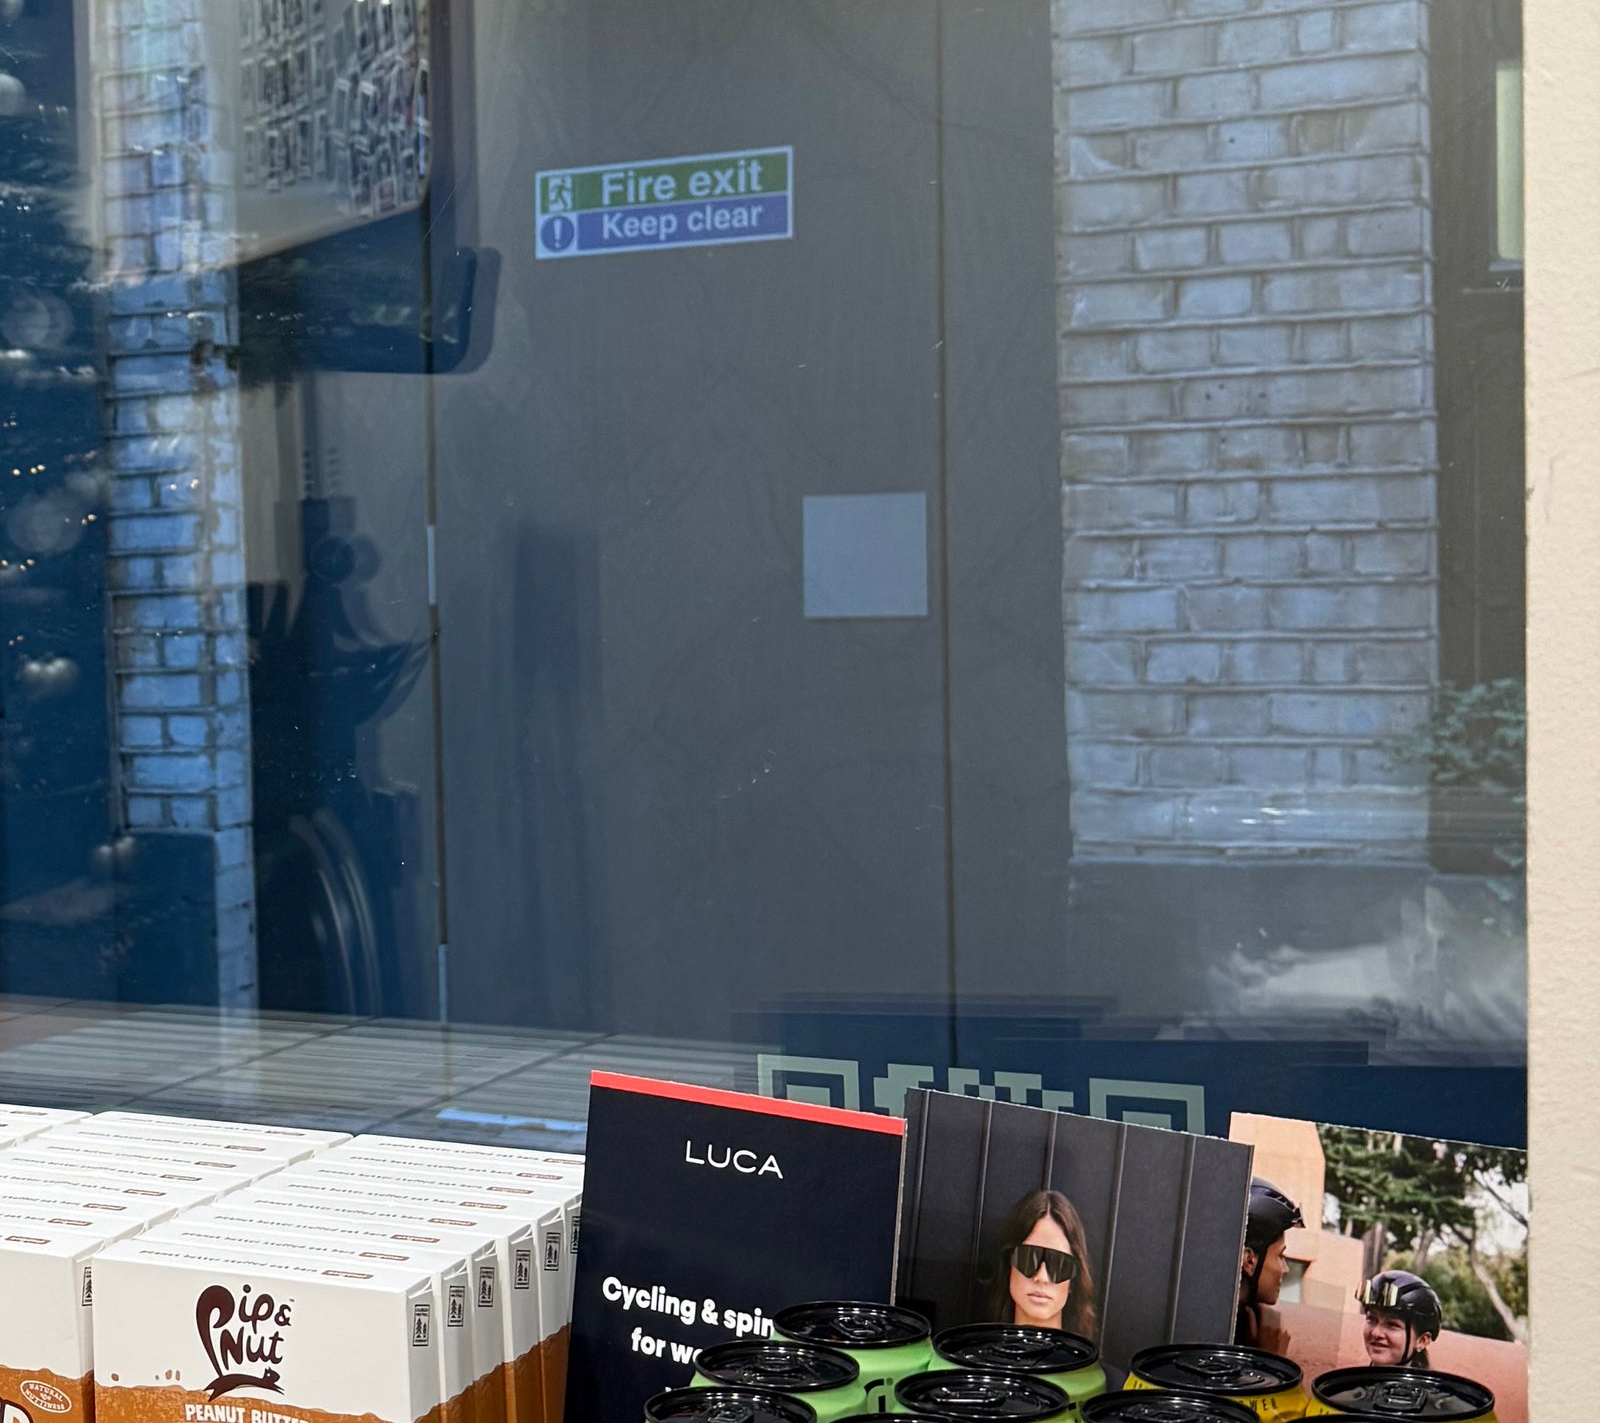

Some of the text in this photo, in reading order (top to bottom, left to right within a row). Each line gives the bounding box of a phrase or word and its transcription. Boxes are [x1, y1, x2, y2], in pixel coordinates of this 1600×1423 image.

[601, 158, 763, 206] Fire exit
[601, 204, 764, 241] Keep clear
[685, 1139, 784, 1180] LUCA
[601, 1276, 697, 1326] Cycling
[700, 1295, 720, 1327] &
[219, 1327, 284, 1371] Nut
[630, 1326, 667, 1360] for
[185, 1404, 245, 1423] PEANUT
